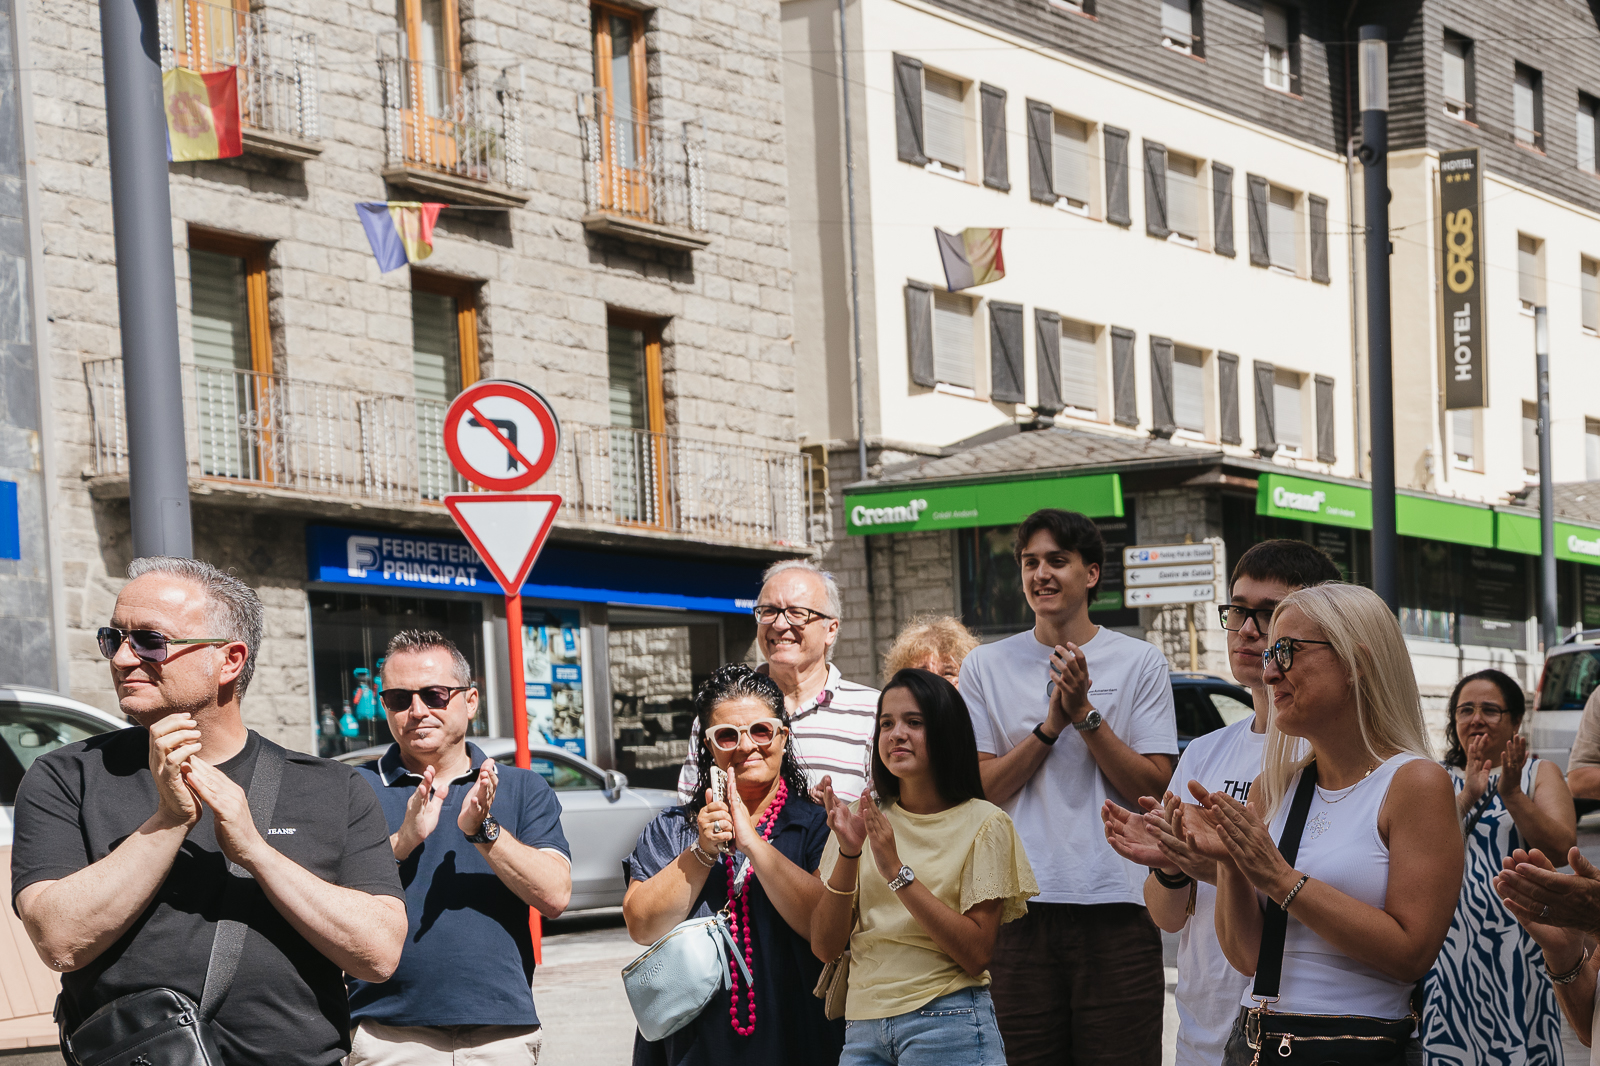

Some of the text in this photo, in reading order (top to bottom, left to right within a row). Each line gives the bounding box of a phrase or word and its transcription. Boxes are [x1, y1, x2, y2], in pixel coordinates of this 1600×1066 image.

[1441, 158, 1474, 171] HOTEL
[1454, 303, 1472, 381] HOTEL
[383, 560, 478, 587] PRINCIPAT
